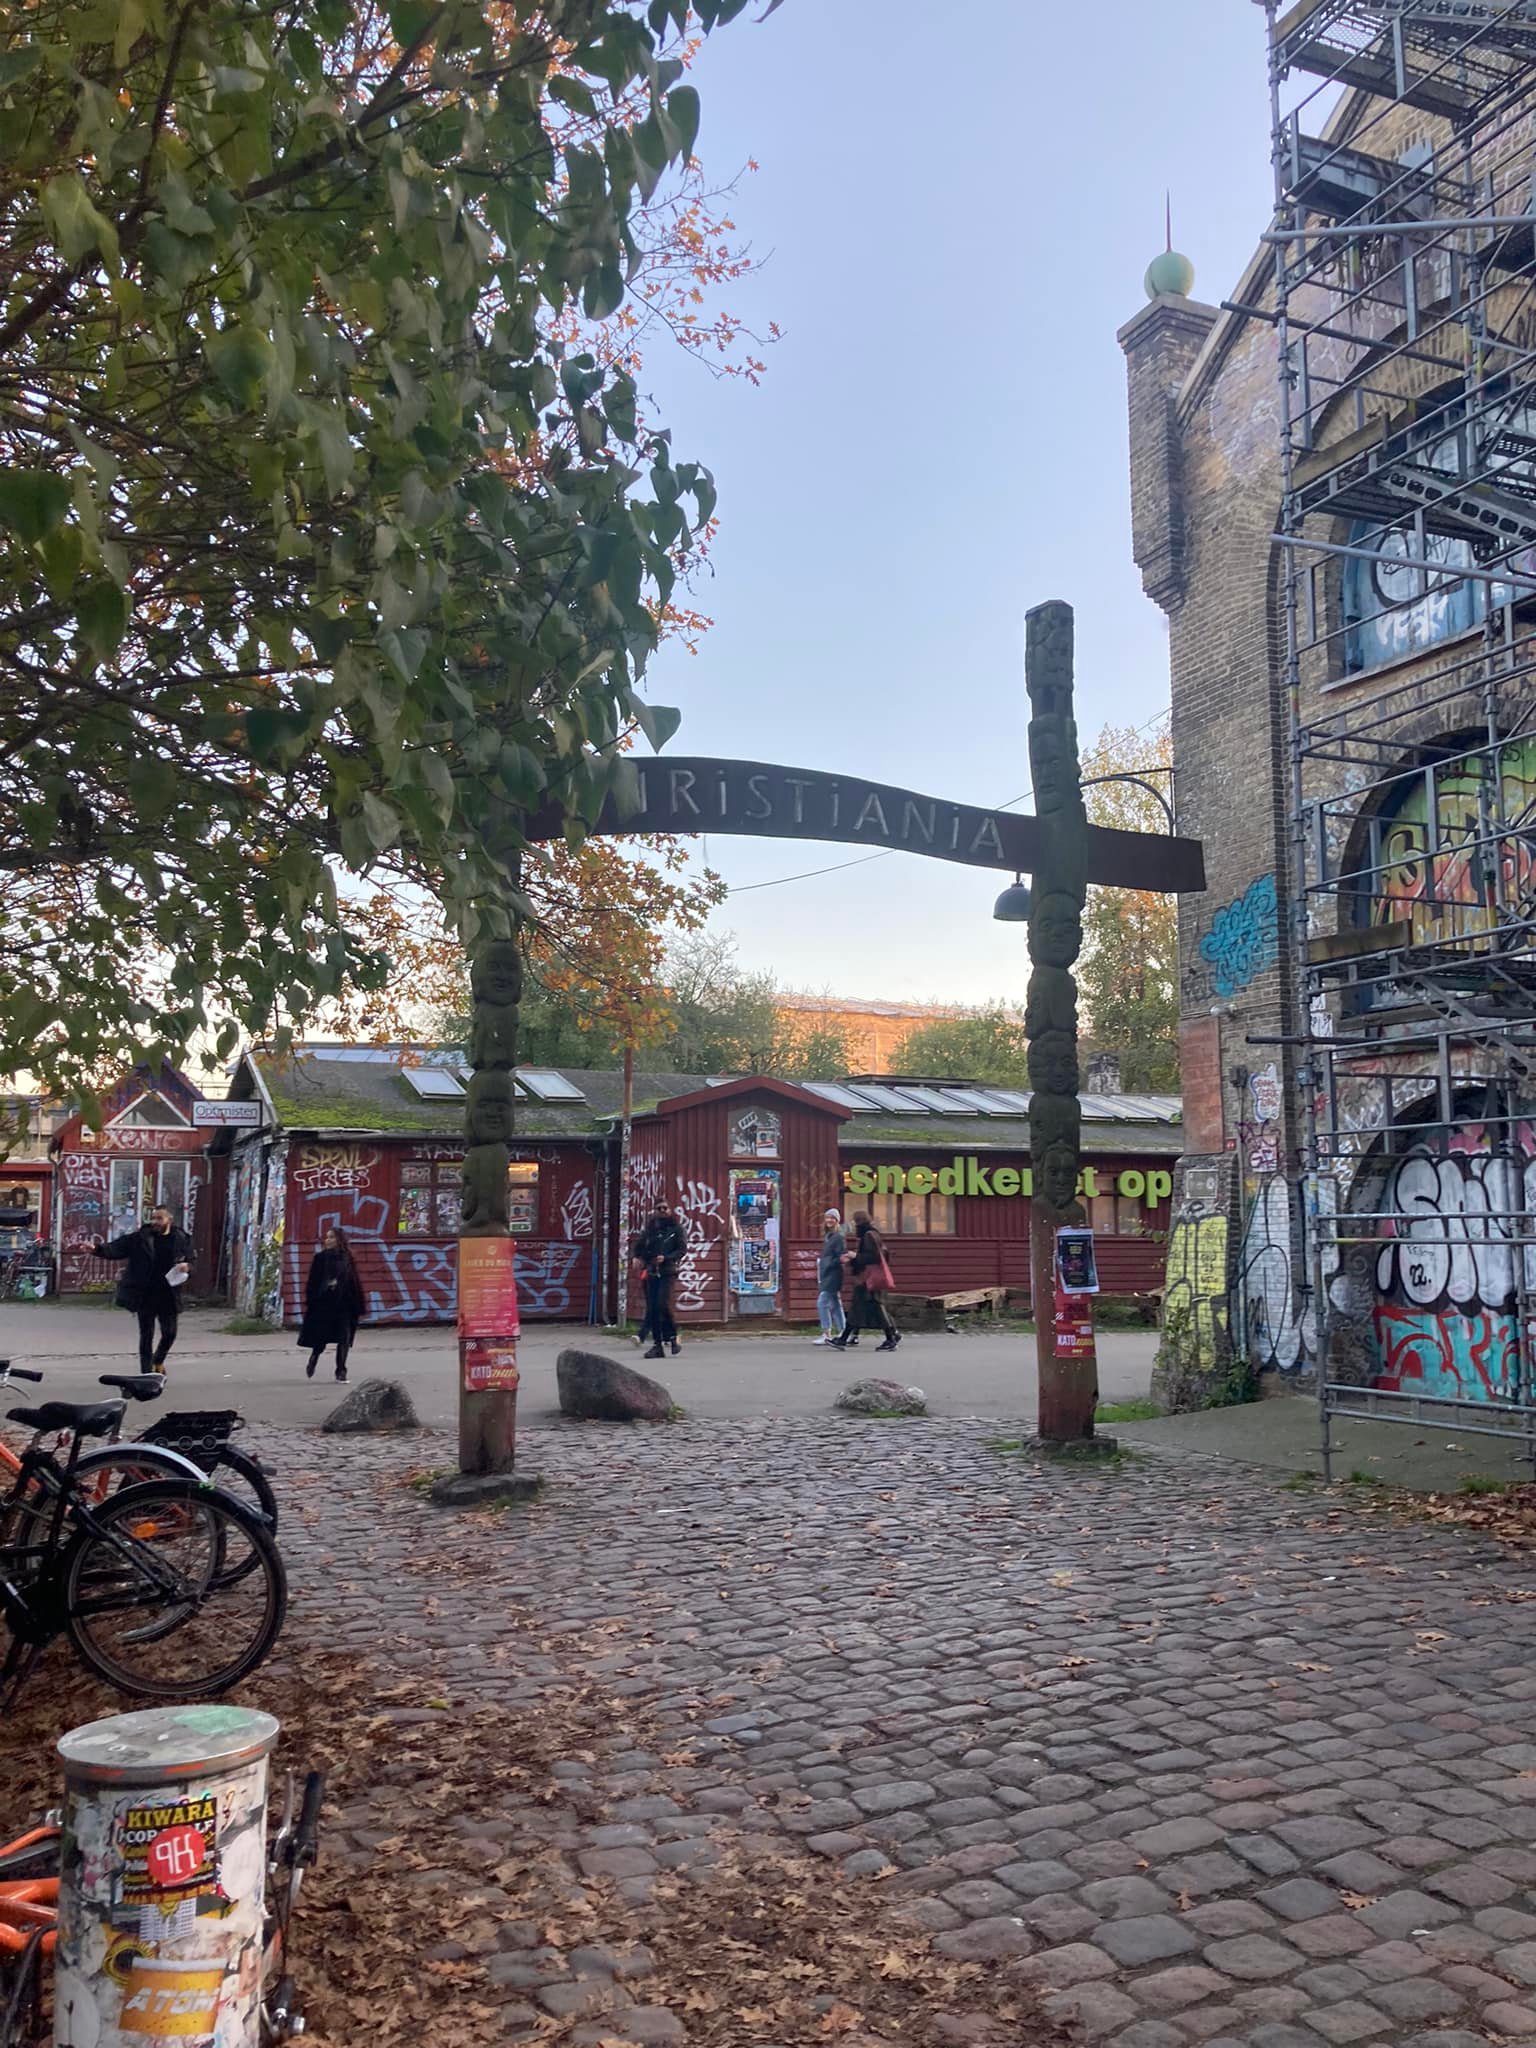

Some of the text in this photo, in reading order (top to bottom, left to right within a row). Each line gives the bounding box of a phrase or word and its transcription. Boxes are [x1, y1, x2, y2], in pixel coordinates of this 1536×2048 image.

[194, 1104, 258, 1120] Optimisten
[850, 1155, 1174, 1207] snedkert op
[127, 1801, 215, 1829] KIWARA
[125, 1987, 219, 2014] ATOM
